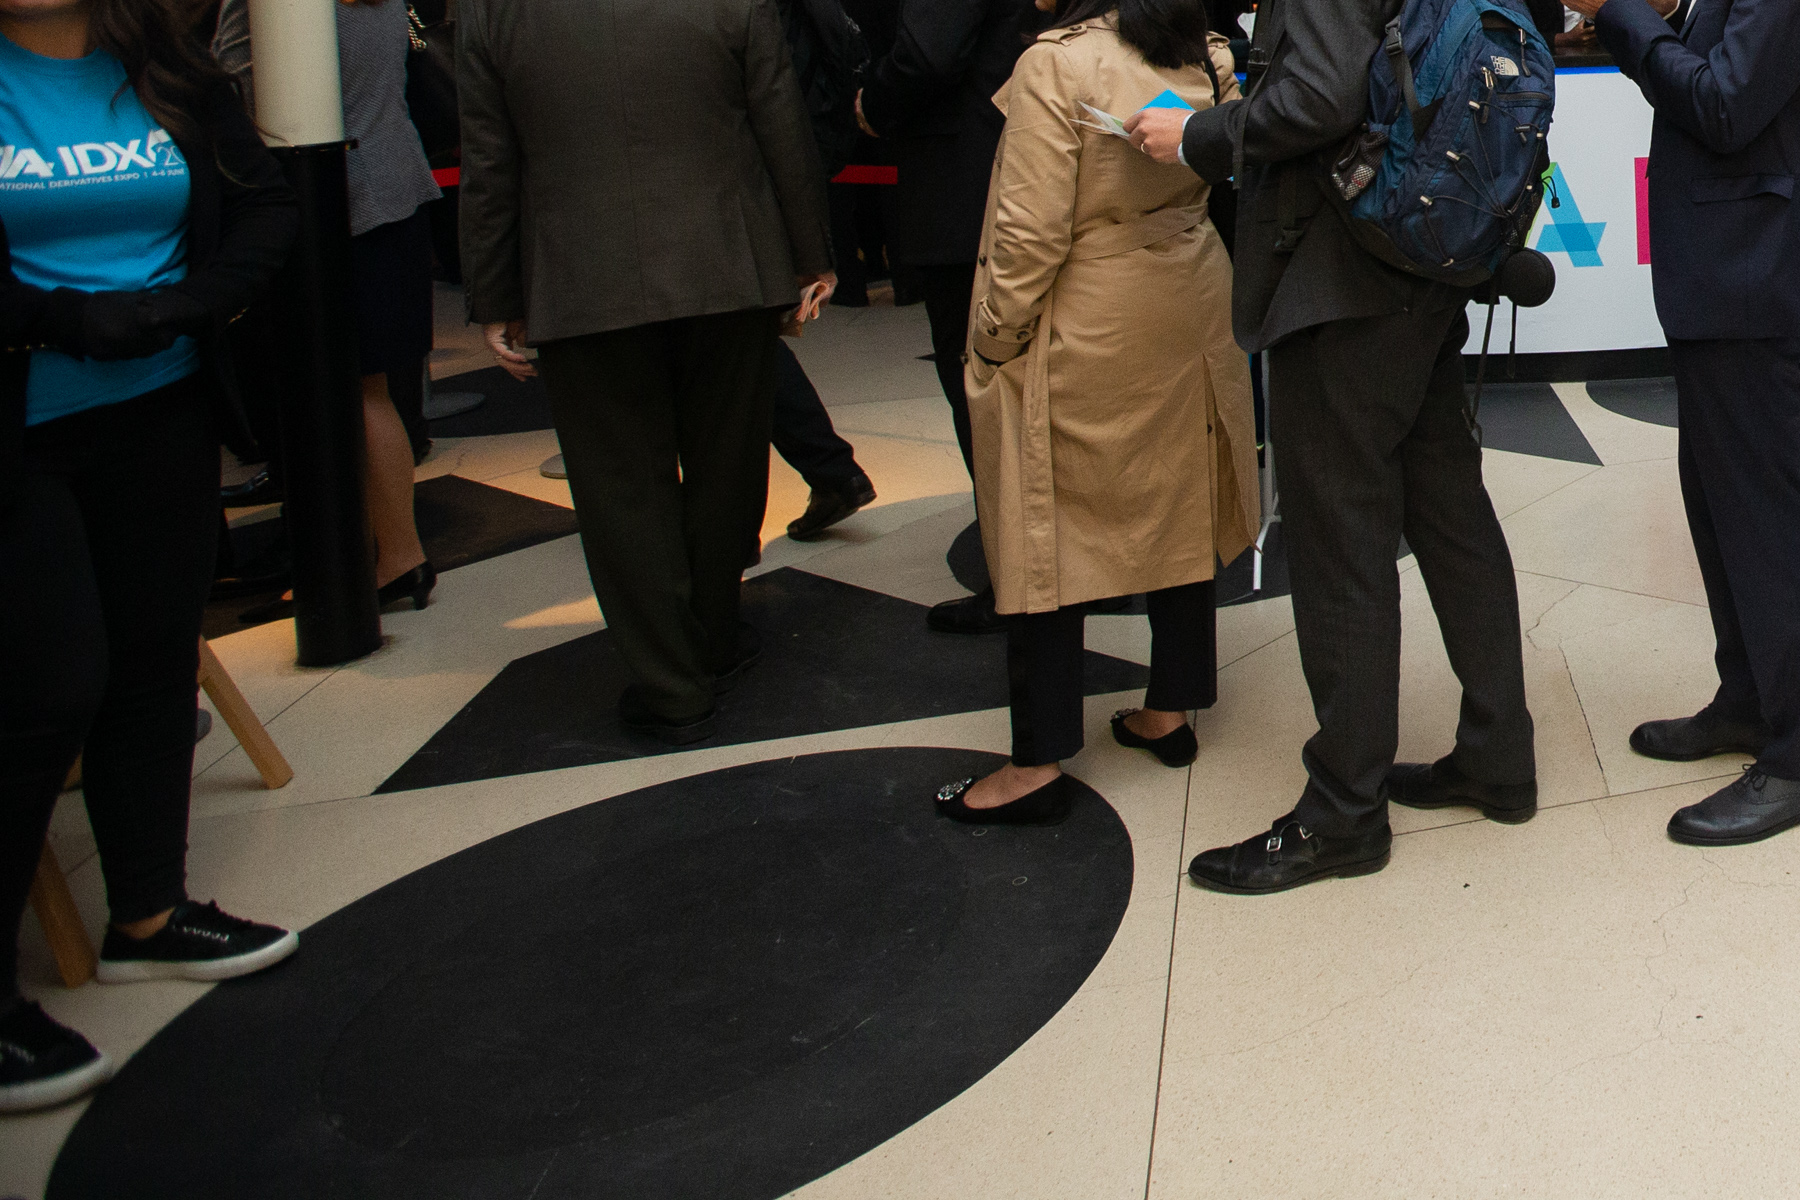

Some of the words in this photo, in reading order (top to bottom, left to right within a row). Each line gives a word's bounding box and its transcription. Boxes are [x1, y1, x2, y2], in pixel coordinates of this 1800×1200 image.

[57, 139, 155, 176] IDX
[48, 174, 113, 189] DERIVATIVES
[113, 172, 140, 182] EXPO
